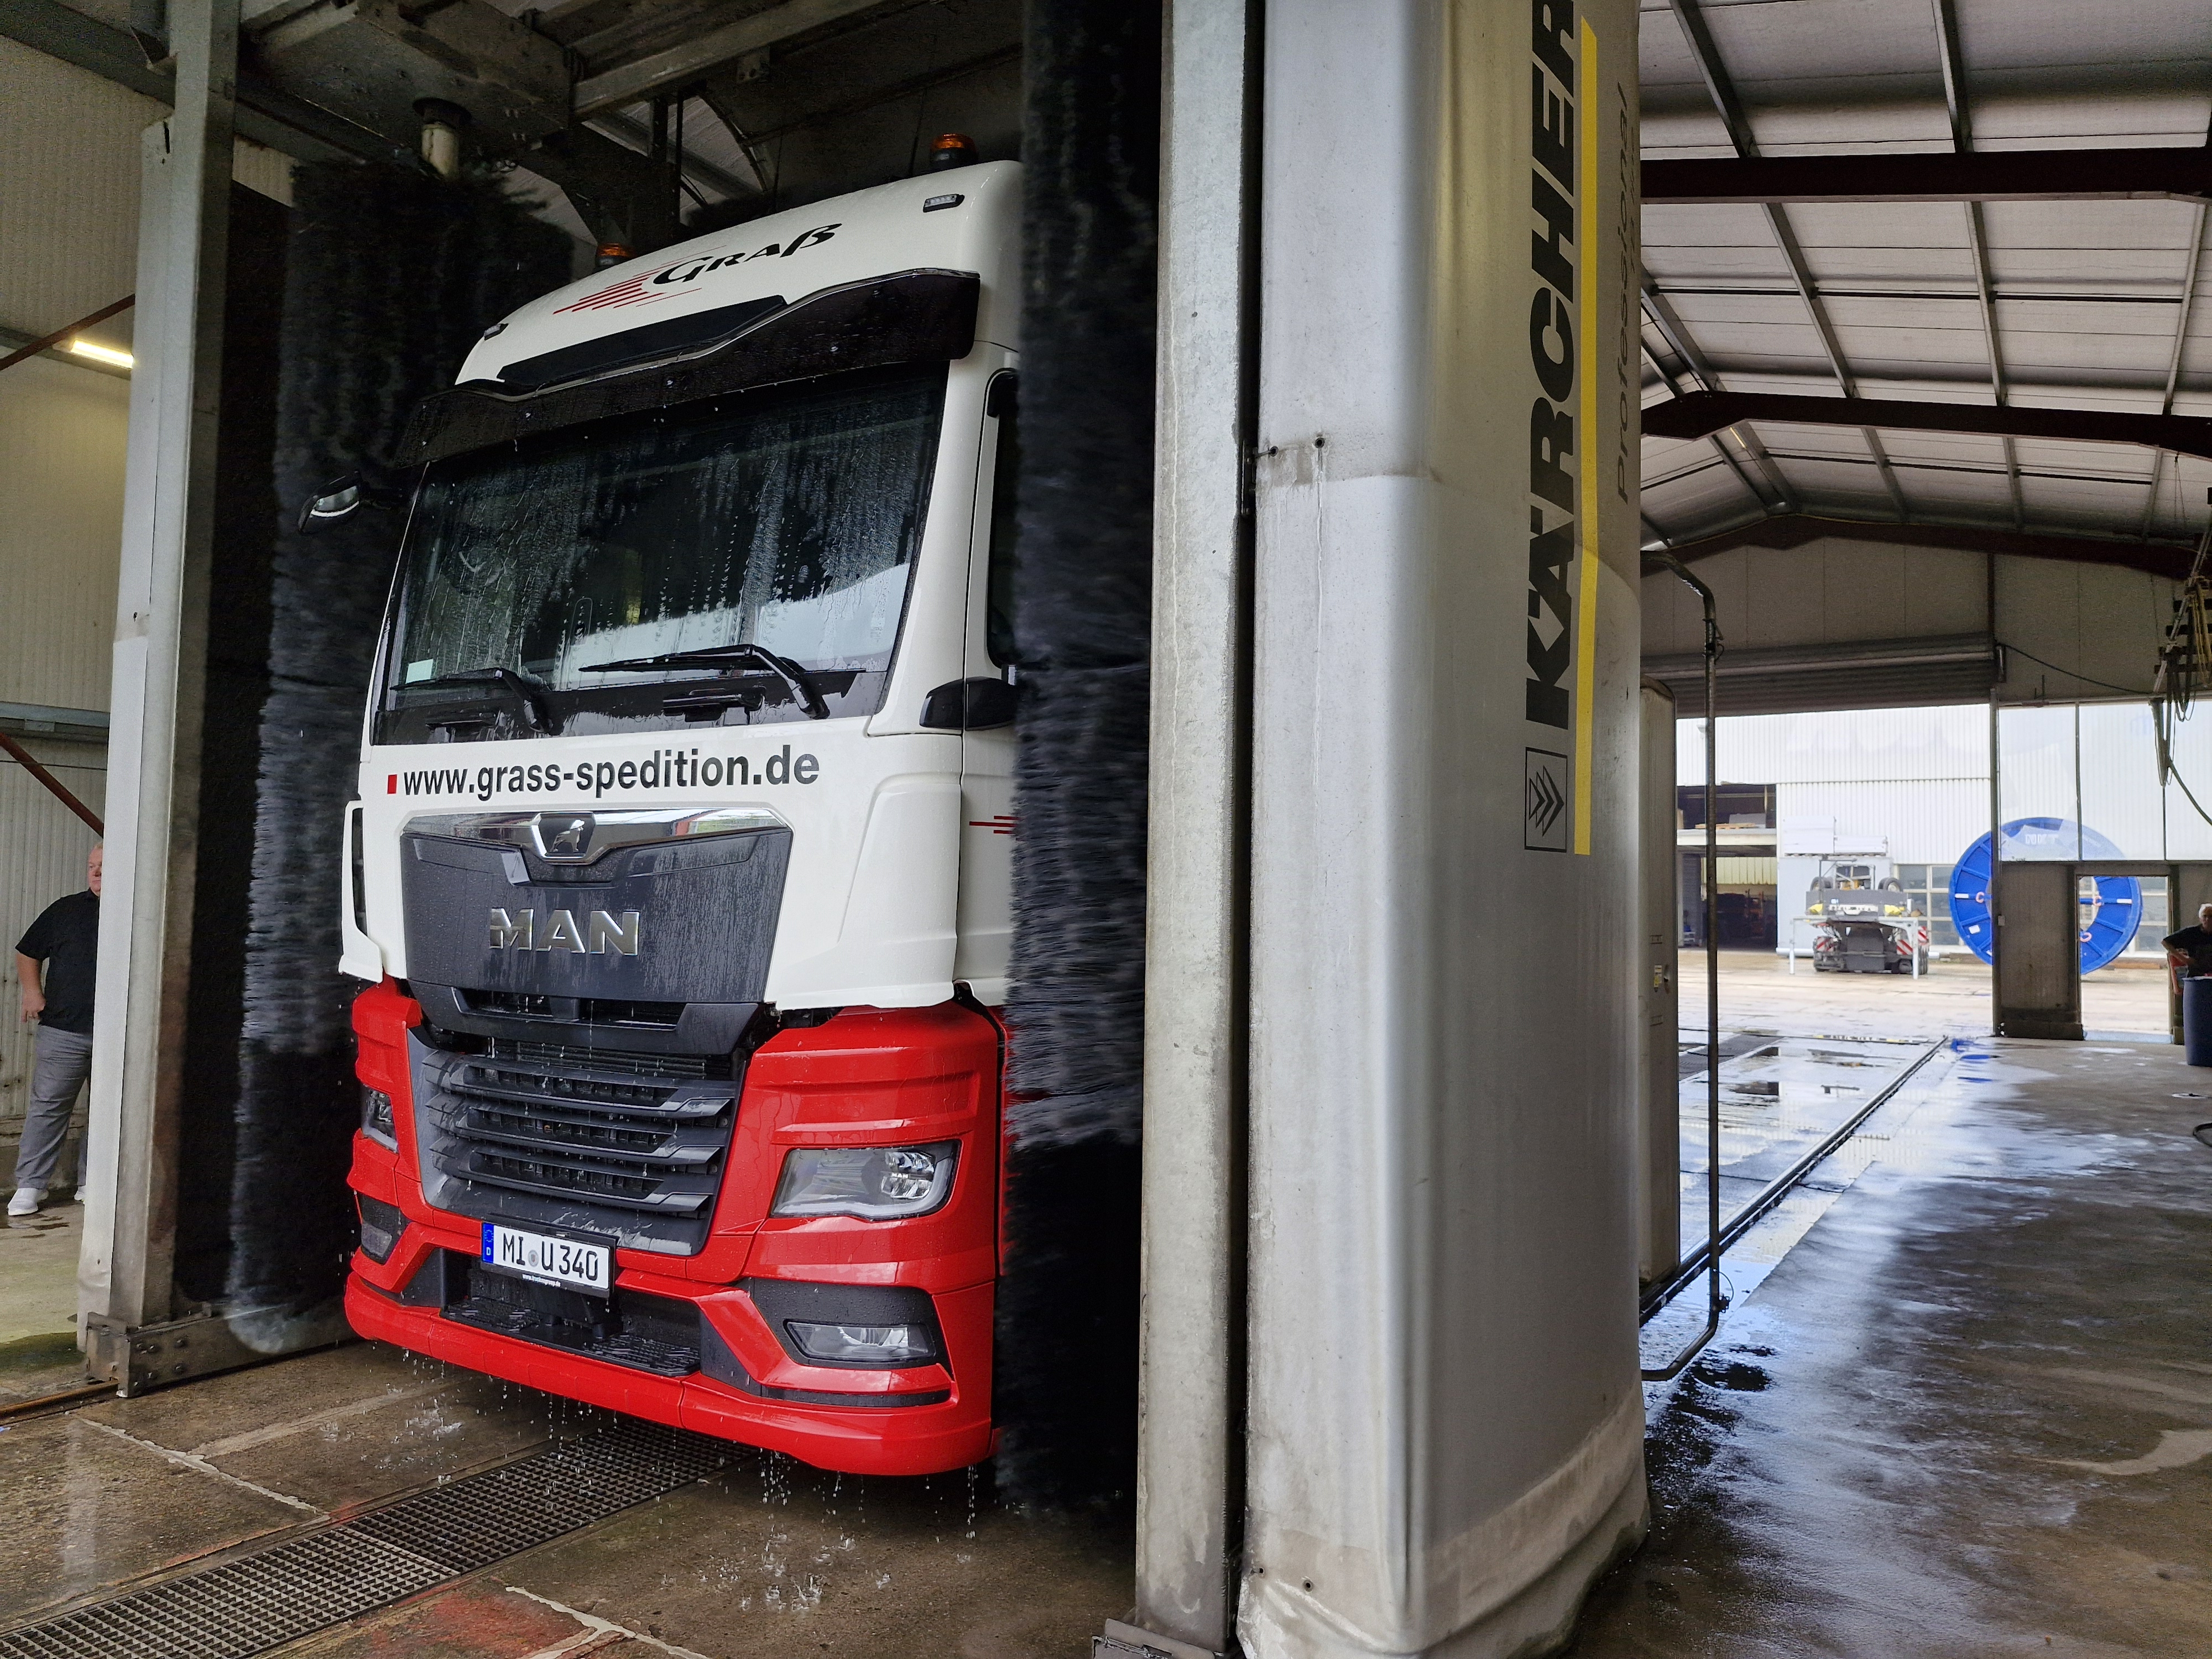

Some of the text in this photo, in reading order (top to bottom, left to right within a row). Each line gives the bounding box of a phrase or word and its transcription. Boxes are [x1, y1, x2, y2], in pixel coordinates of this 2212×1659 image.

[1618, 81, 1628, 505] Professional
[1526, 0, 1574, 729] KÄRCHER
[404, 744, 820, 801] www.grass-spedition.de
[489, 907, 640, 956] MAN
[486, 1246, 491, 1256] D
[503, 1233, 525, 1266] MI
[541, 1241, 554, 1272] U
[559, 1245, 598, 1281] 340
